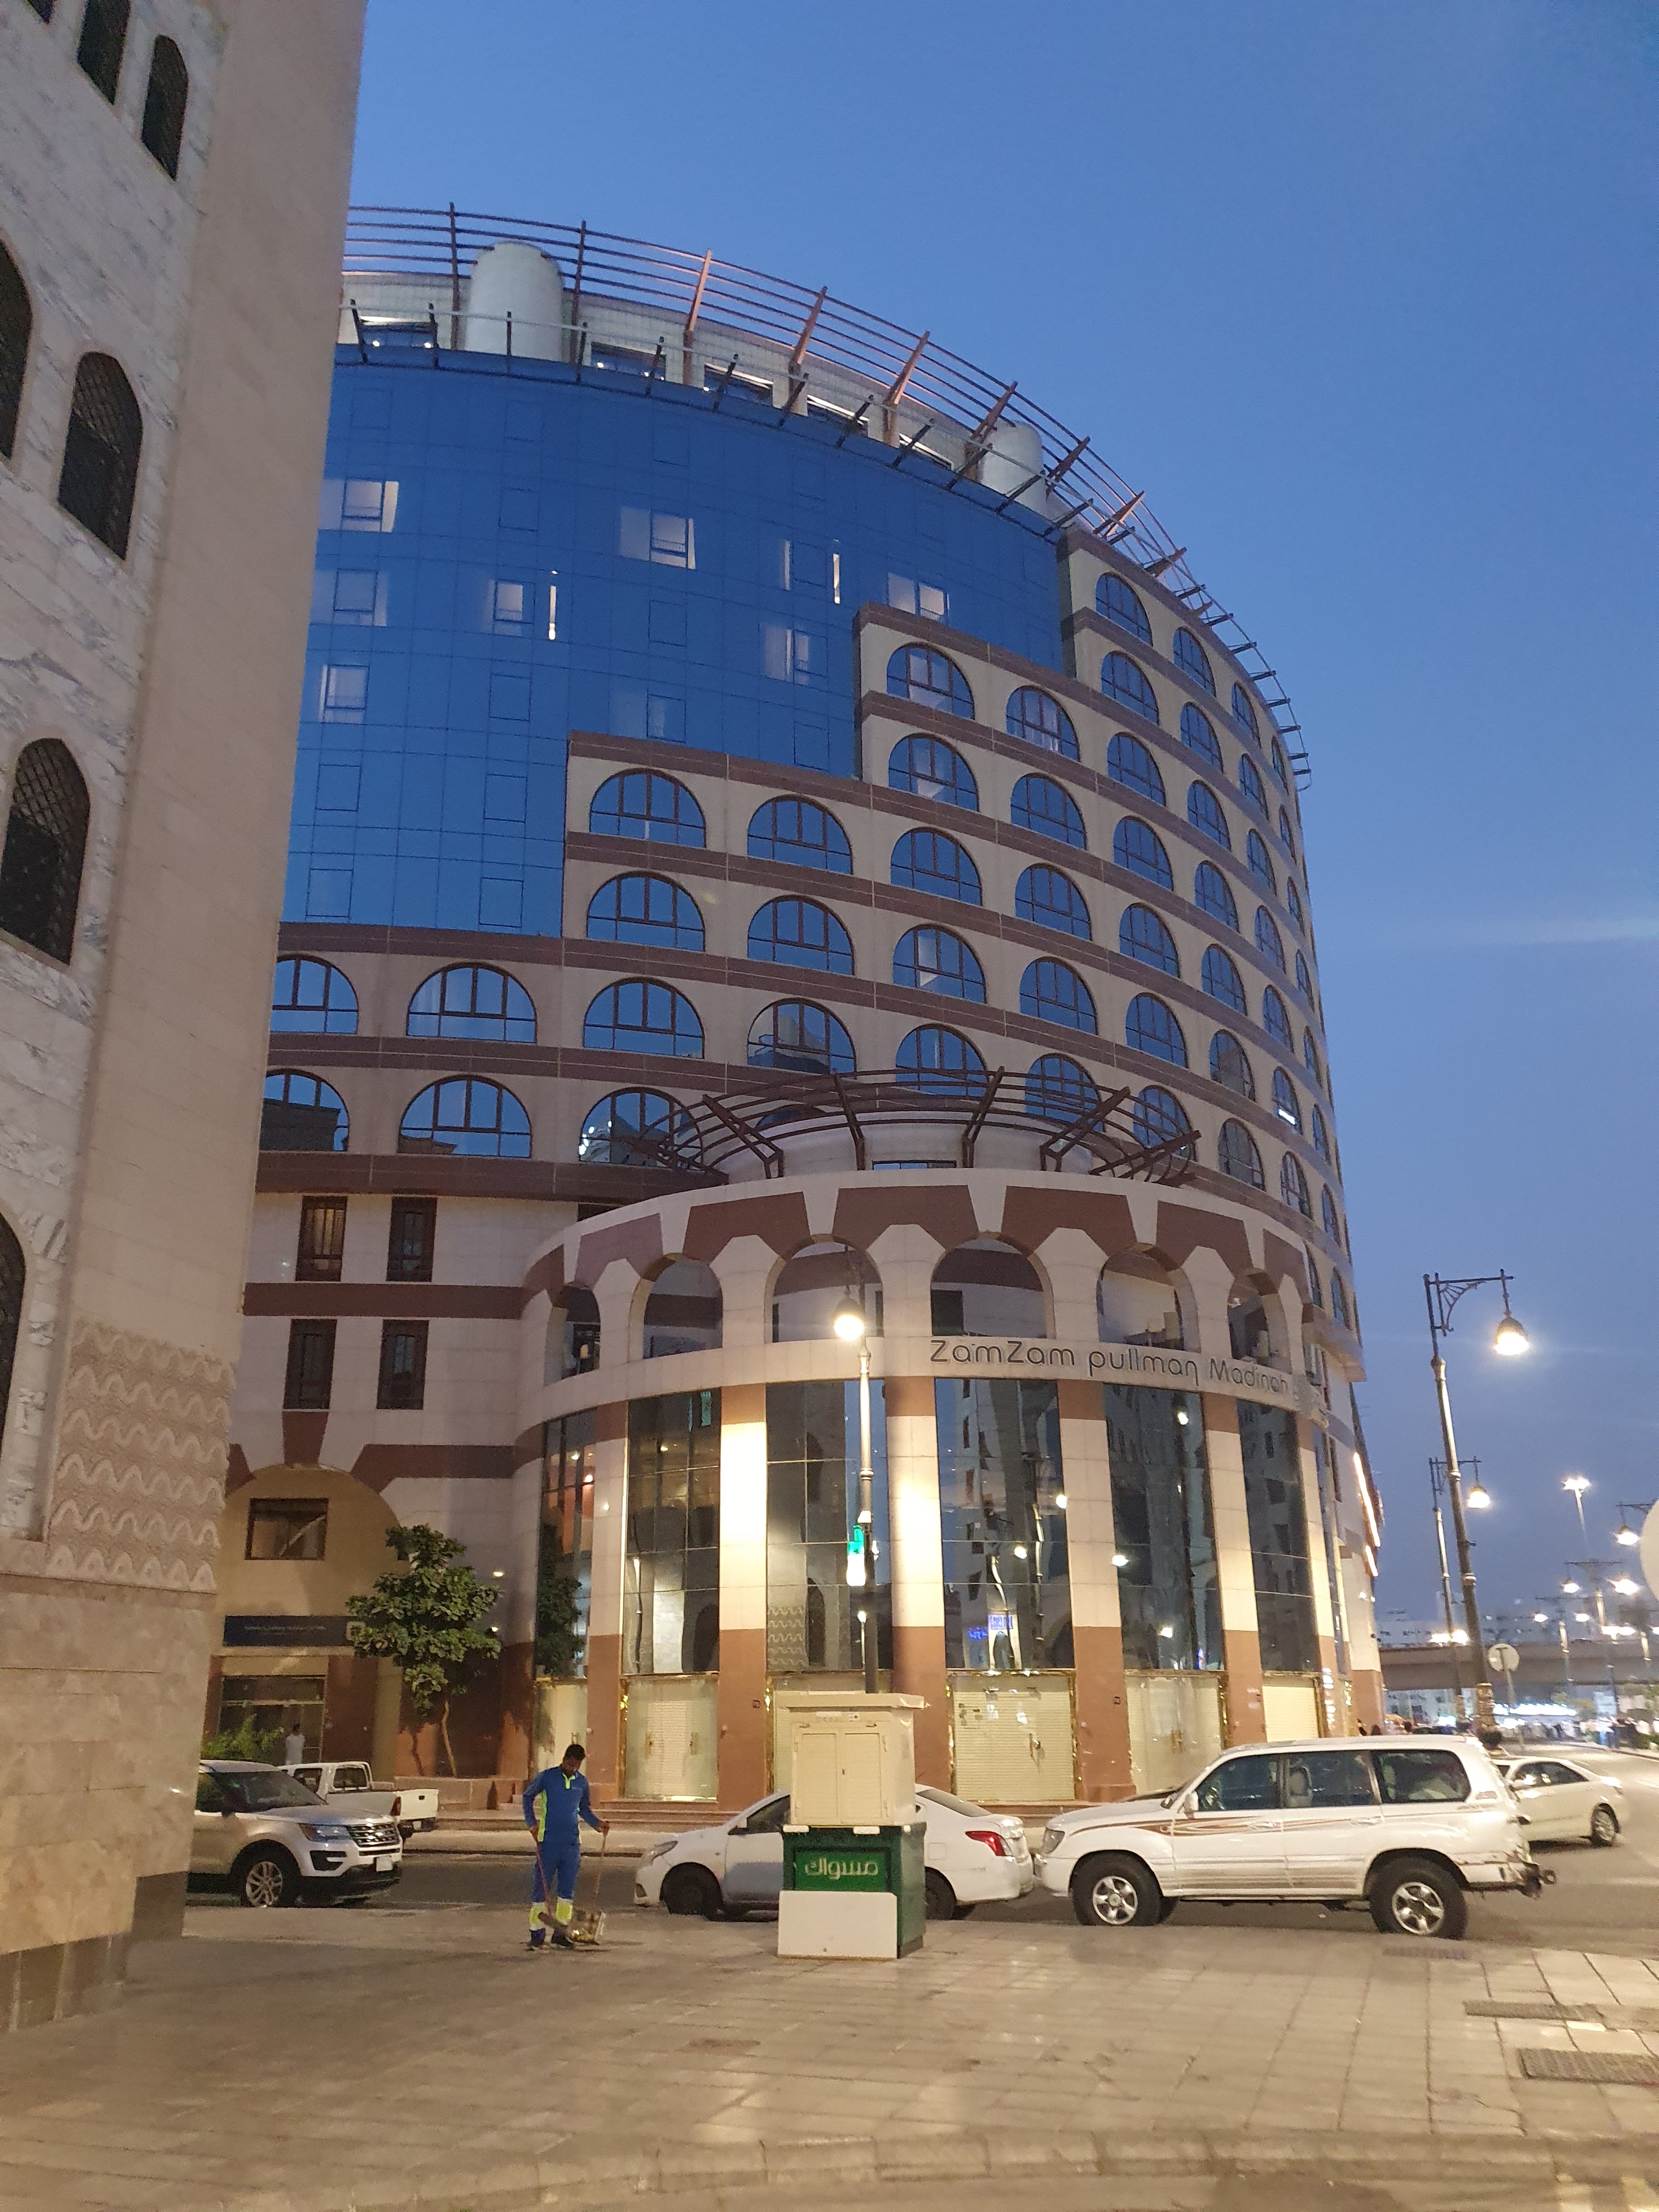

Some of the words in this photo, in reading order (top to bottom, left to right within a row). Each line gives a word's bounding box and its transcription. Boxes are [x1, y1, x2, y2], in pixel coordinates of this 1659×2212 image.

[930, 1339, 1075, 1365] ZamZam
[1089, 1348, 1199, 1386] pullman
[1209, 1357, 1288, 1392] Madinah
